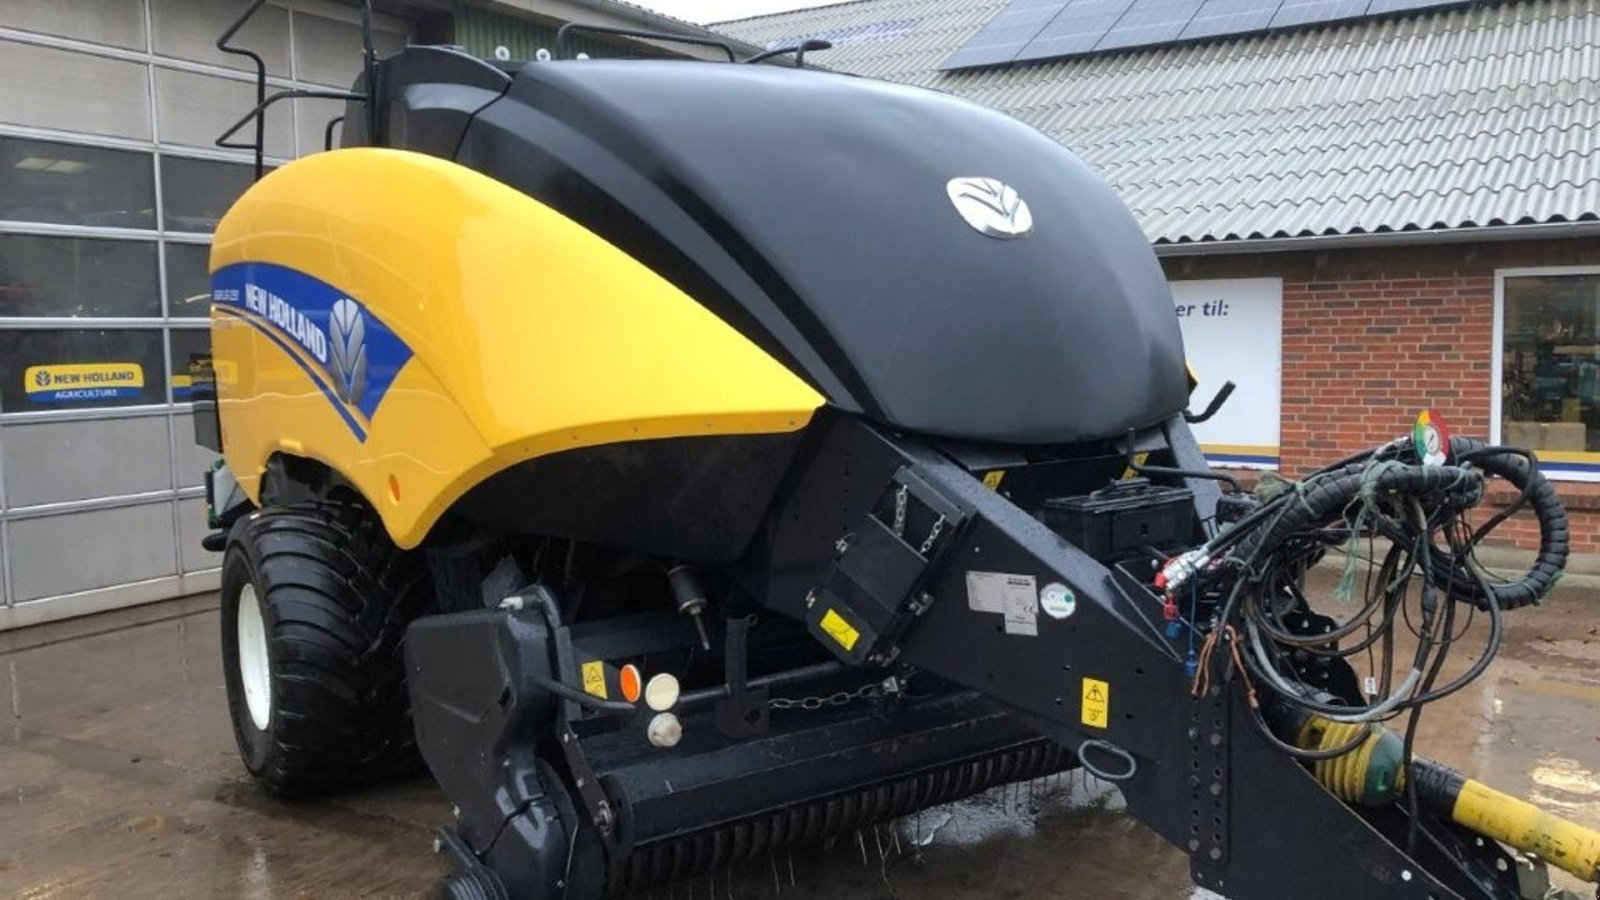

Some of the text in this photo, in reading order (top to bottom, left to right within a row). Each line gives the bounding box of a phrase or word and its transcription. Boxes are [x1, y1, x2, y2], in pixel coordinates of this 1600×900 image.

[1202, 299, 1229, 316] til:
[245, 283, 327, 363] NEW HOLLAND
[54, 371, 134, 383] NEW HOLLAND
[54, 389, 117, 398] AGRICULTURE
